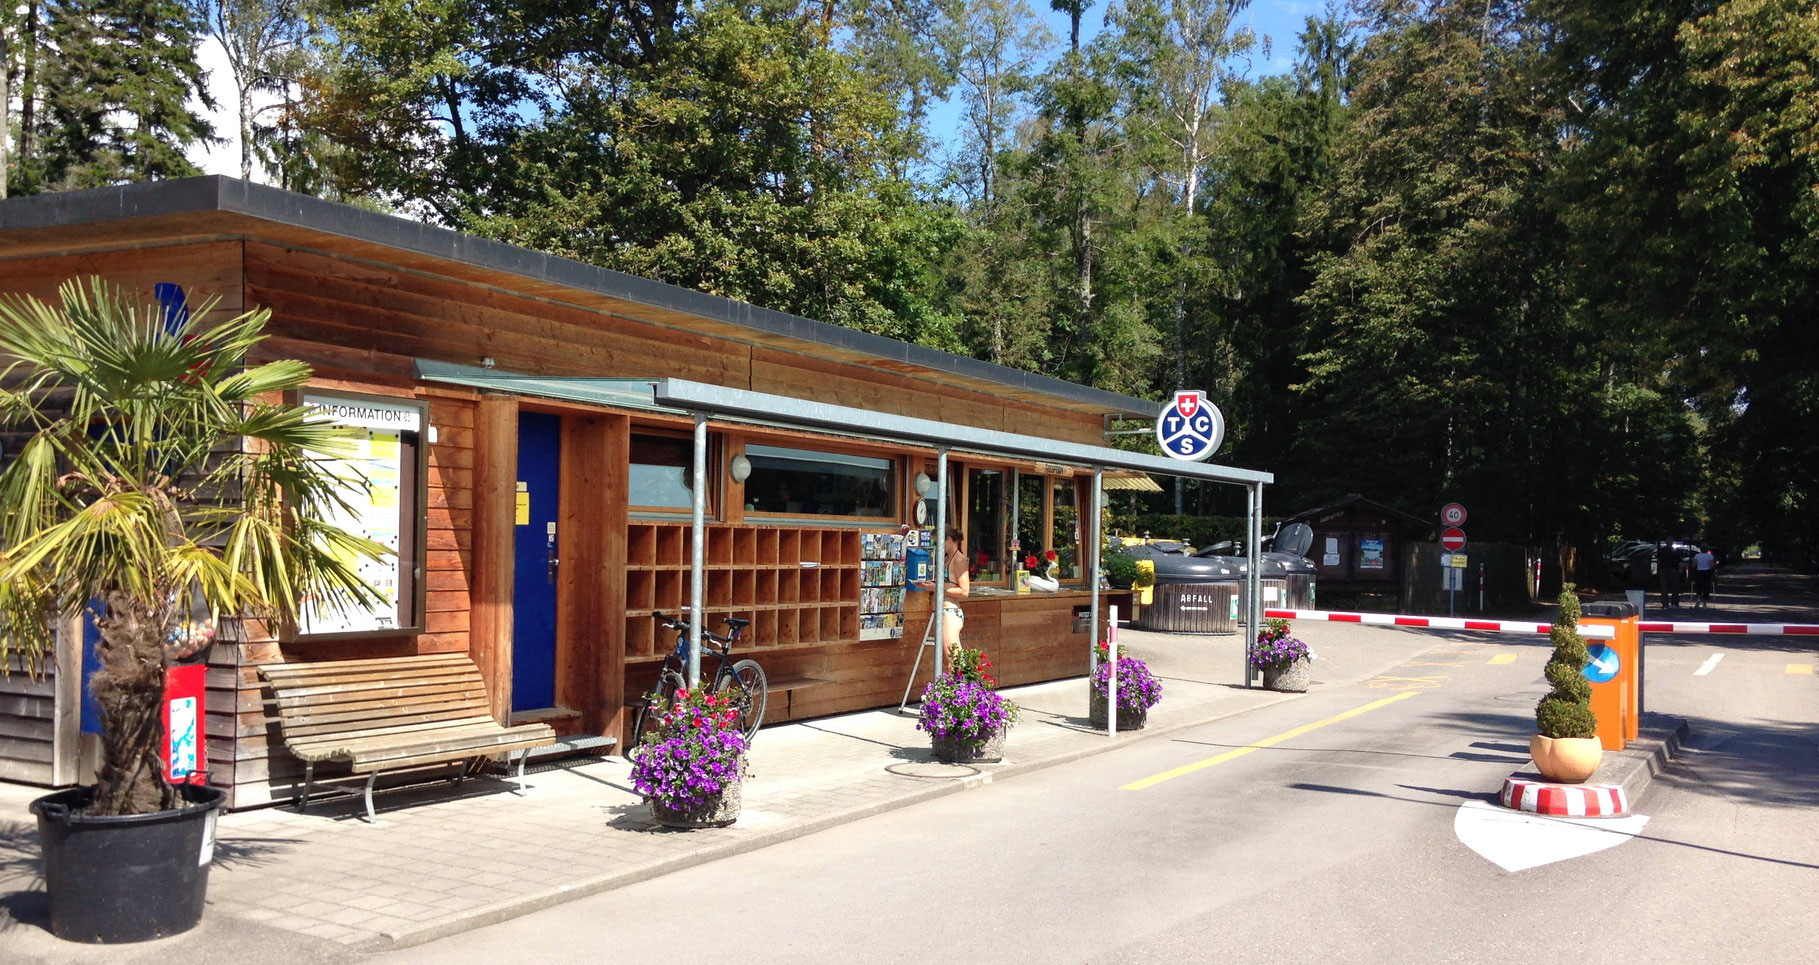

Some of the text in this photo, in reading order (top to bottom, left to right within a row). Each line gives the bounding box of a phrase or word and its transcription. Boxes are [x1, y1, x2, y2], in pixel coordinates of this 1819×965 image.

[319, 403, 401, 422] INFORMATION
[1449, 511, 1459, 520] 40
[1180, 593, 1213, 604] ABFALL
